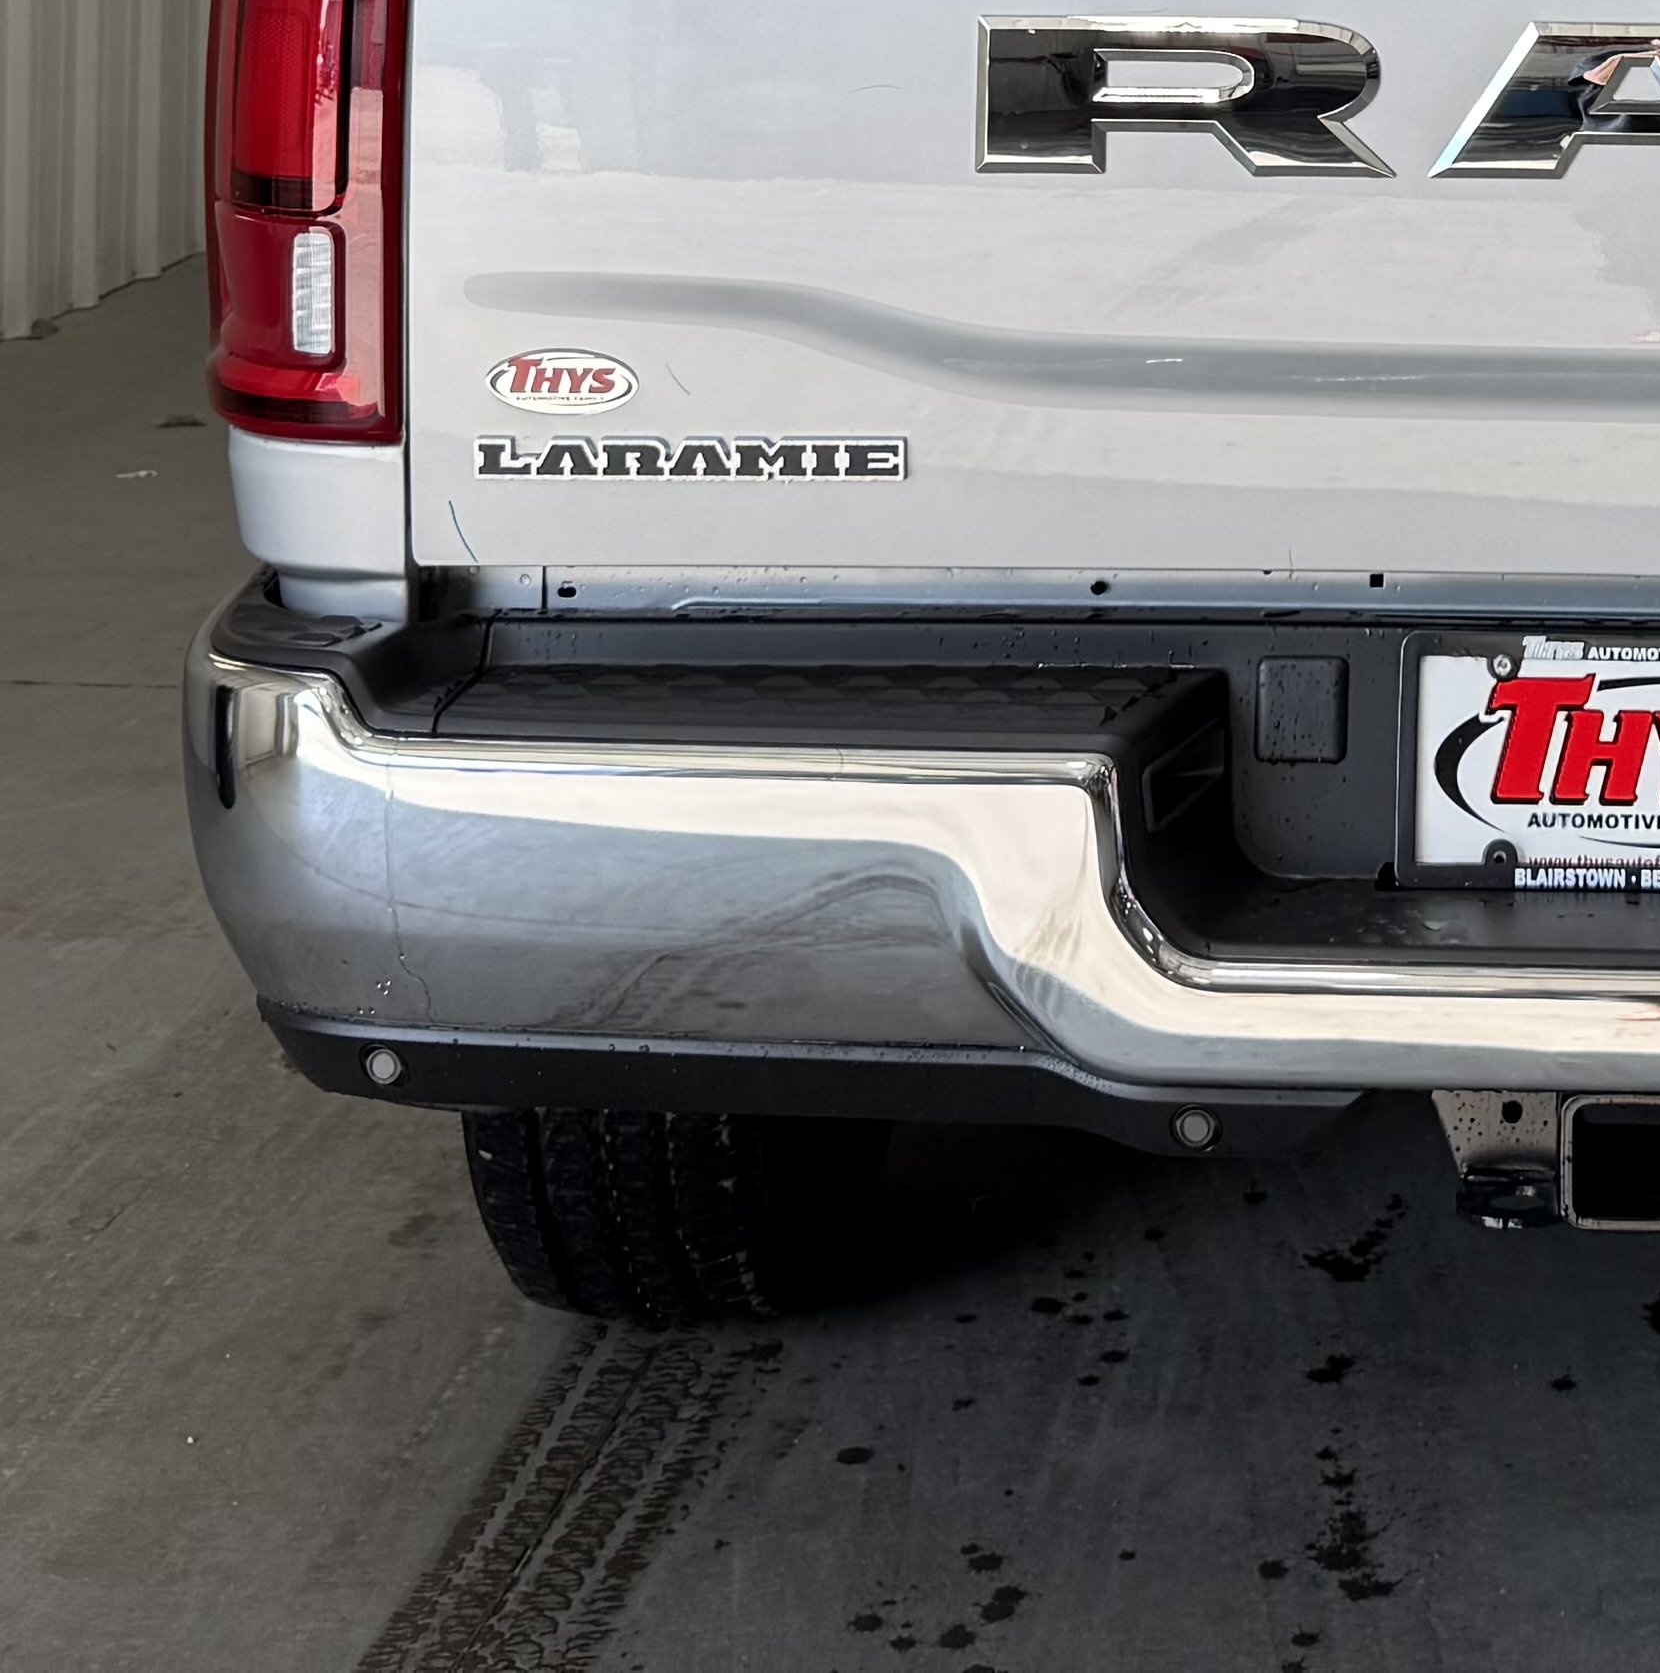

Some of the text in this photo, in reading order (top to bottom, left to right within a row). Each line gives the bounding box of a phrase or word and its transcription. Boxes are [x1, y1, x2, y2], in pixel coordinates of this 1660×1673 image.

[507, 356, 616, 394] THYS
[474, 435, 908, 482] LARAMIE
[1514, 867, 1626, 889] BLAIRSTOWN
